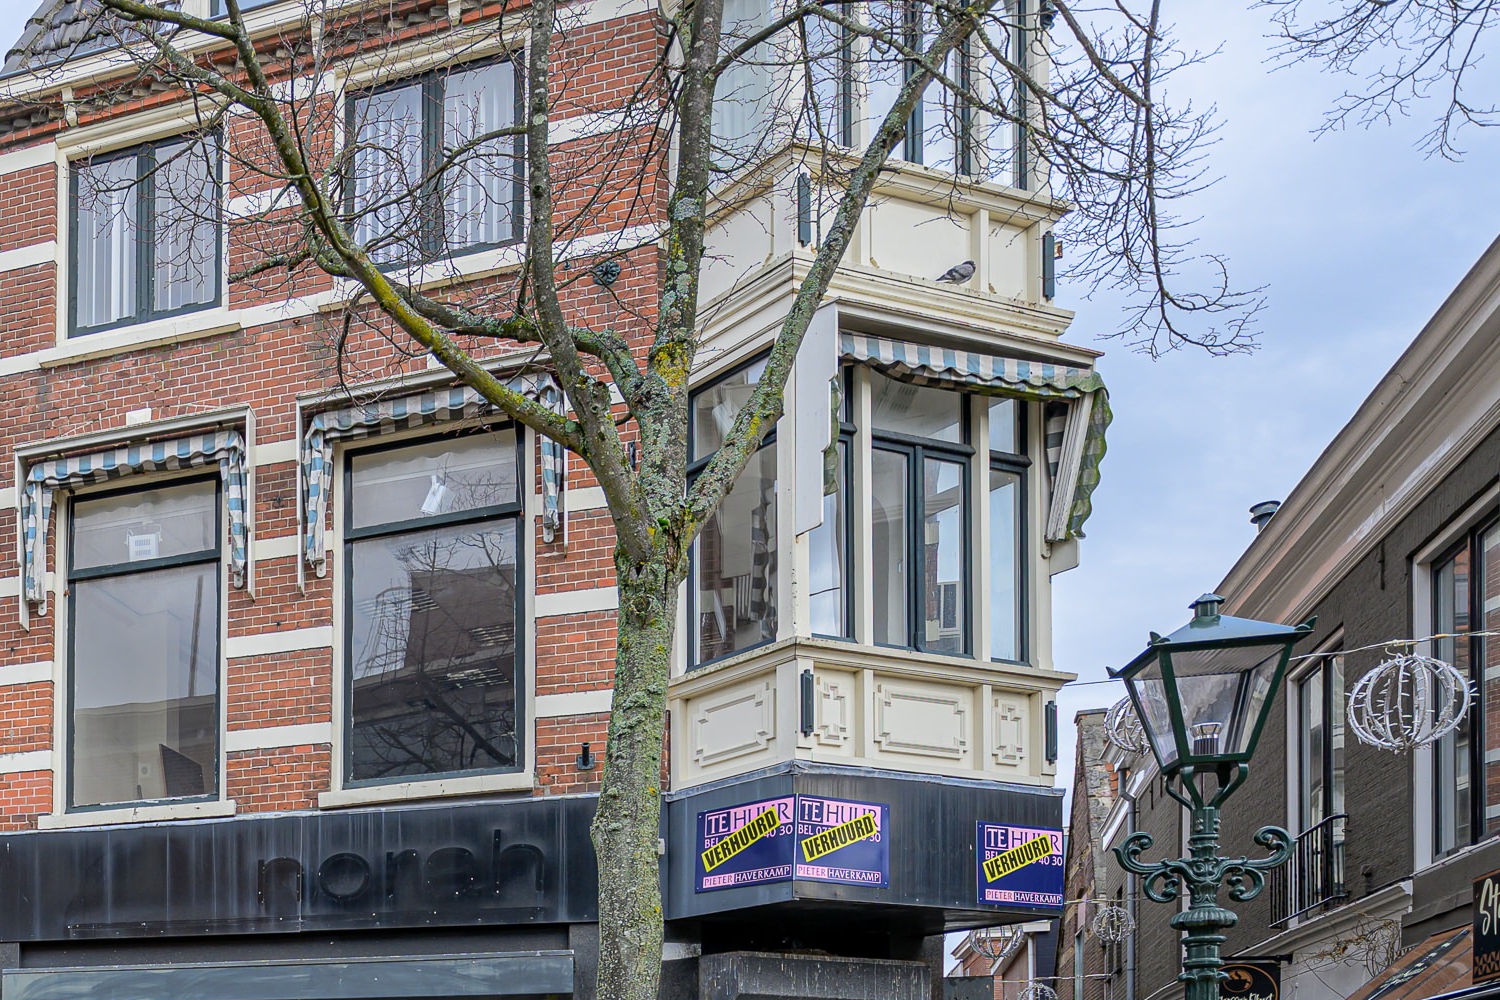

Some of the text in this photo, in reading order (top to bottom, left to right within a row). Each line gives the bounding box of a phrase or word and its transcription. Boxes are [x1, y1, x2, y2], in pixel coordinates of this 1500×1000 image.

[801, 800, 822, 822] TE
[707, 813, 730, 835] TE
[779, 824, 794, 836] 30
[798, 824, 814, 835] BEL
[704, 810, 778, 869] VERHUURD
[803, 815, 874, 859] VERHUURD
[986, 828, 1007, 848] TE
[985, 836, 1050, 879] VERHUURD
[1051, 857, 1063, 866] 30
[704, 866, 791, 887] PIETER HAVERKAMP
[798, 866, 880, 882] PIETER HAVERKAMP
[986, 890, 1062, 904] PIETER HAVERKAMP
